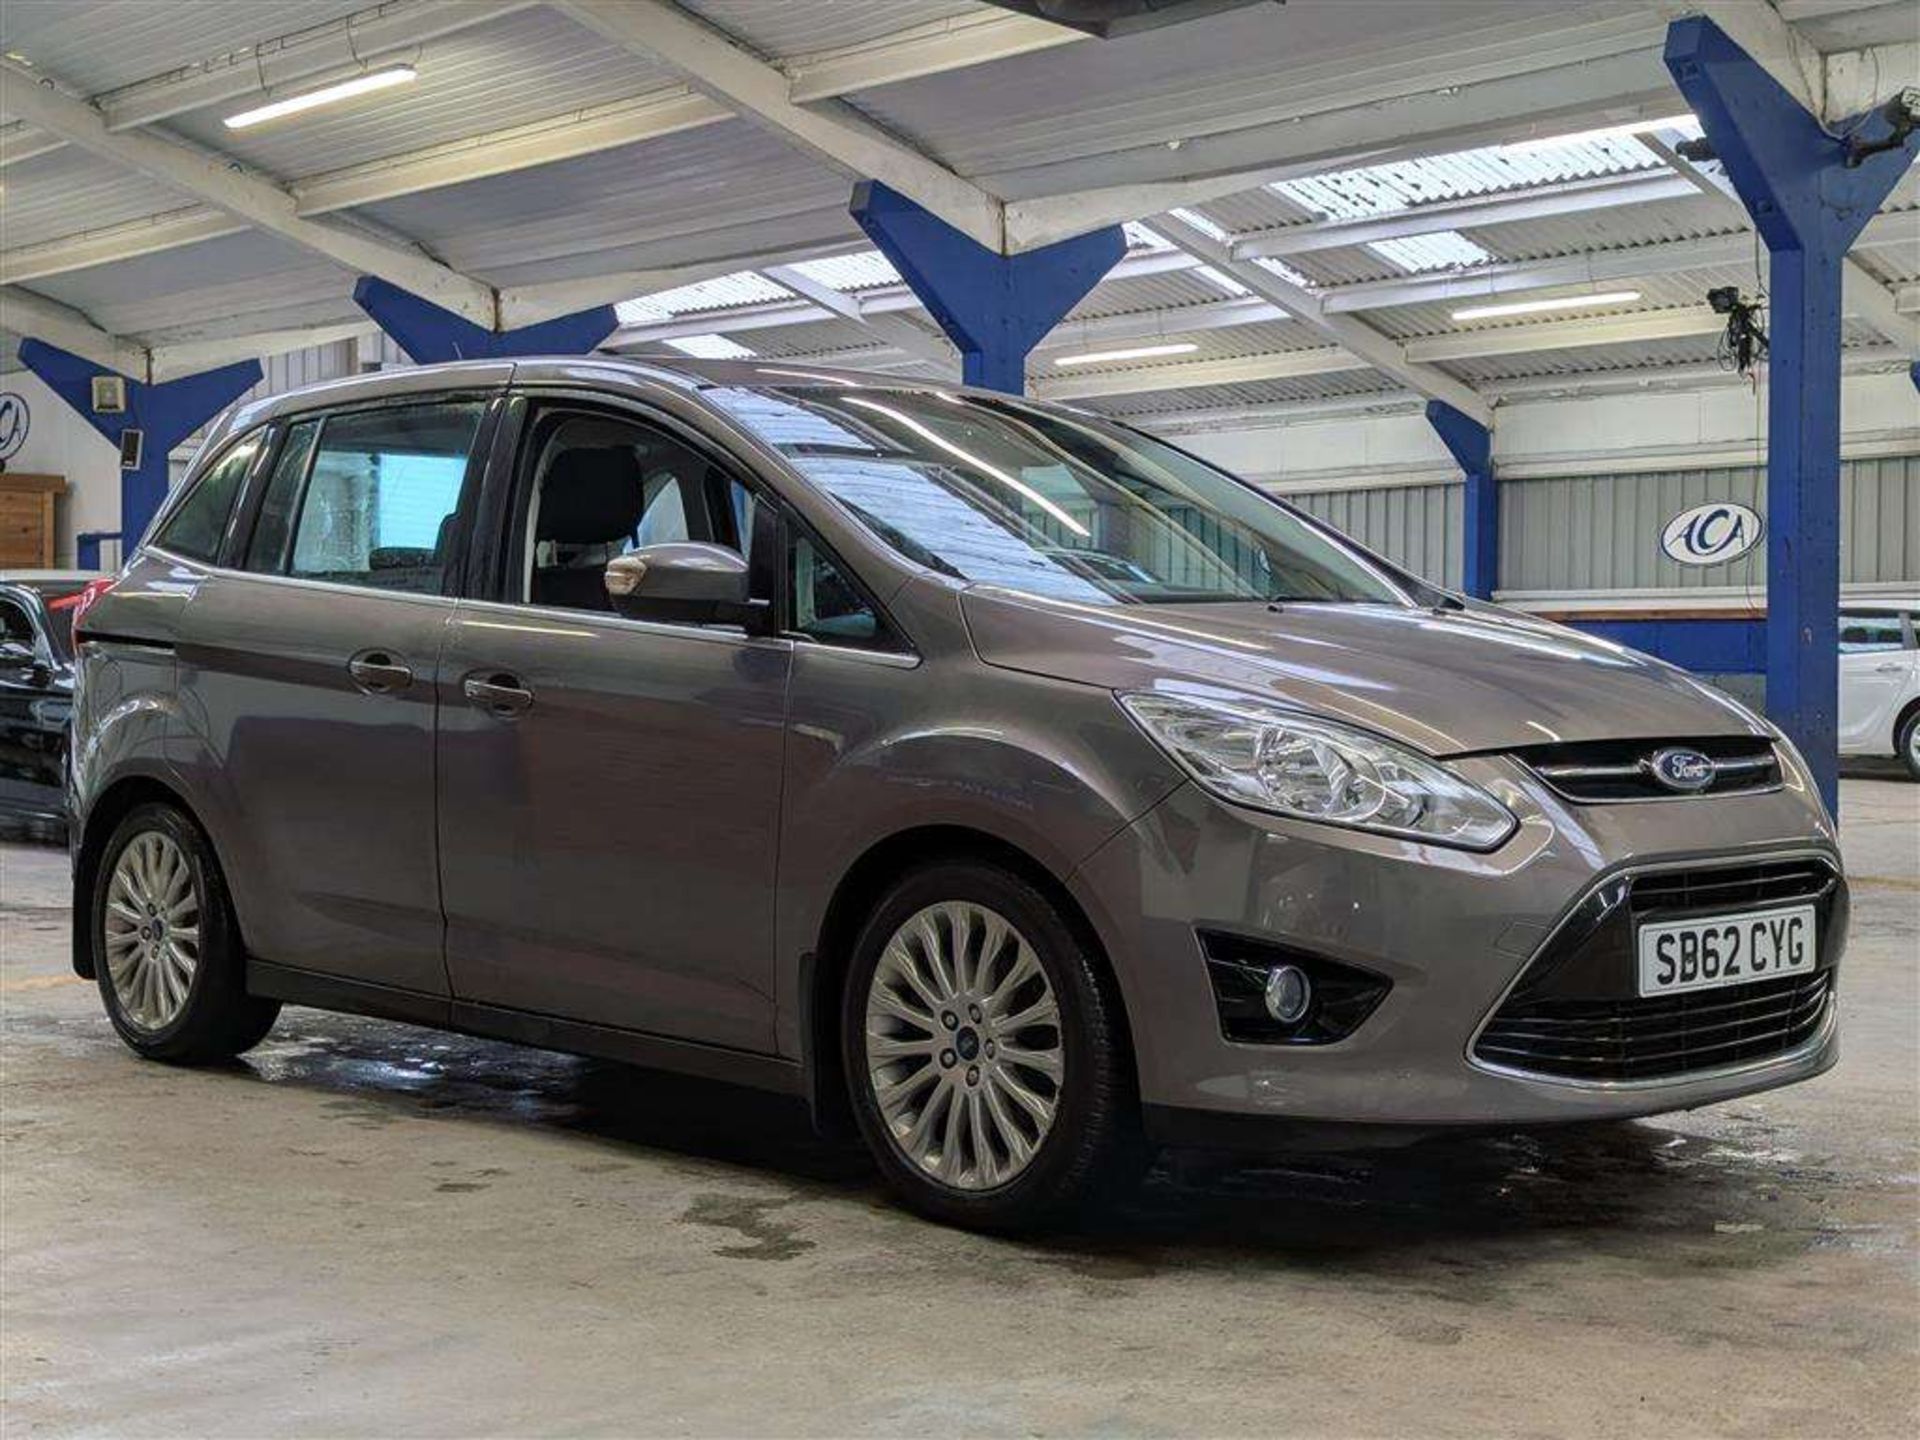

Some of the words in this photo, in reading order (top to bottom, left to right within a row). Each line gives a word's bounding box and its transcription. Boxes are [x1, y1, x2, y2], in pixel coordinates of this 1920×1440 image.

[1667, 508, 1745, 556] ACA
[1671, 754, 1705, 779] Ford
[1656, 925, 1741, 985] SB62
[1750, 916, 1803, 972] CYG
